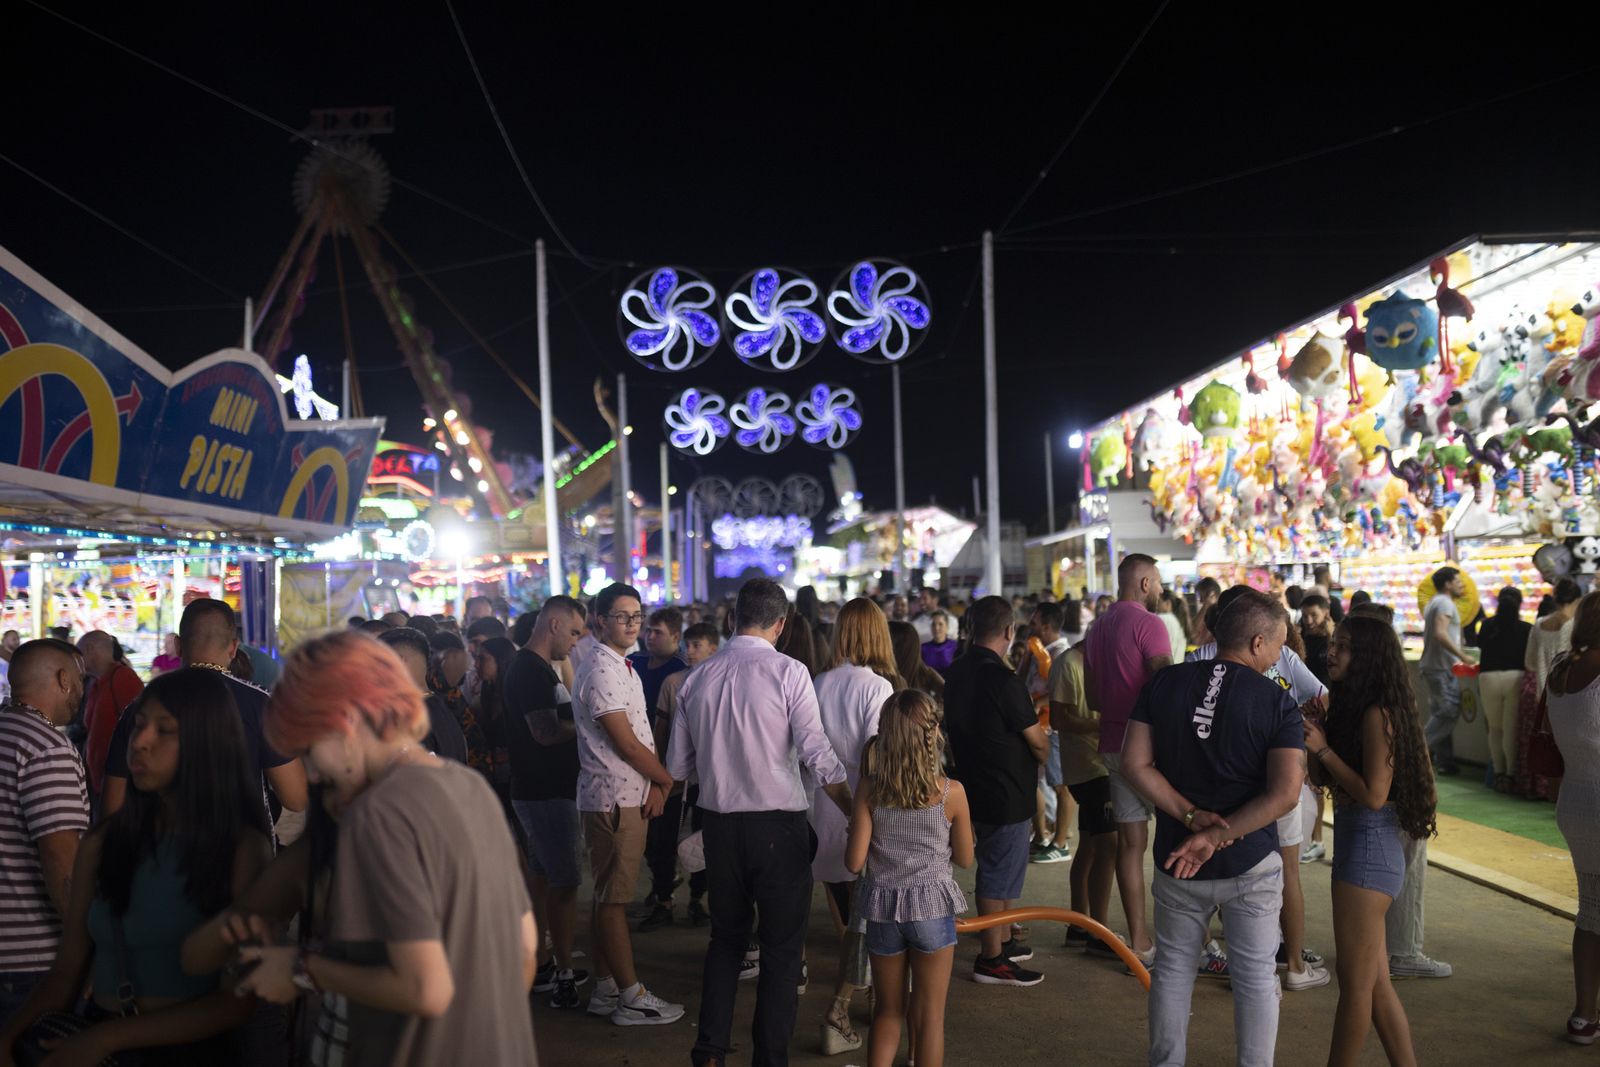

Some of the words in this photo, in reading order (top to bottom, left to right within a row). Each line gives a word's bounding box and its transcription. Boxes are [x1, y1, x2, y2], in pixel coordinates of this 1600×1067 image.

[209, 386, 258, 435] MINI
[180, 435, 253, 500] PISTA
[1193, 664, 1227, 739] ellesse
